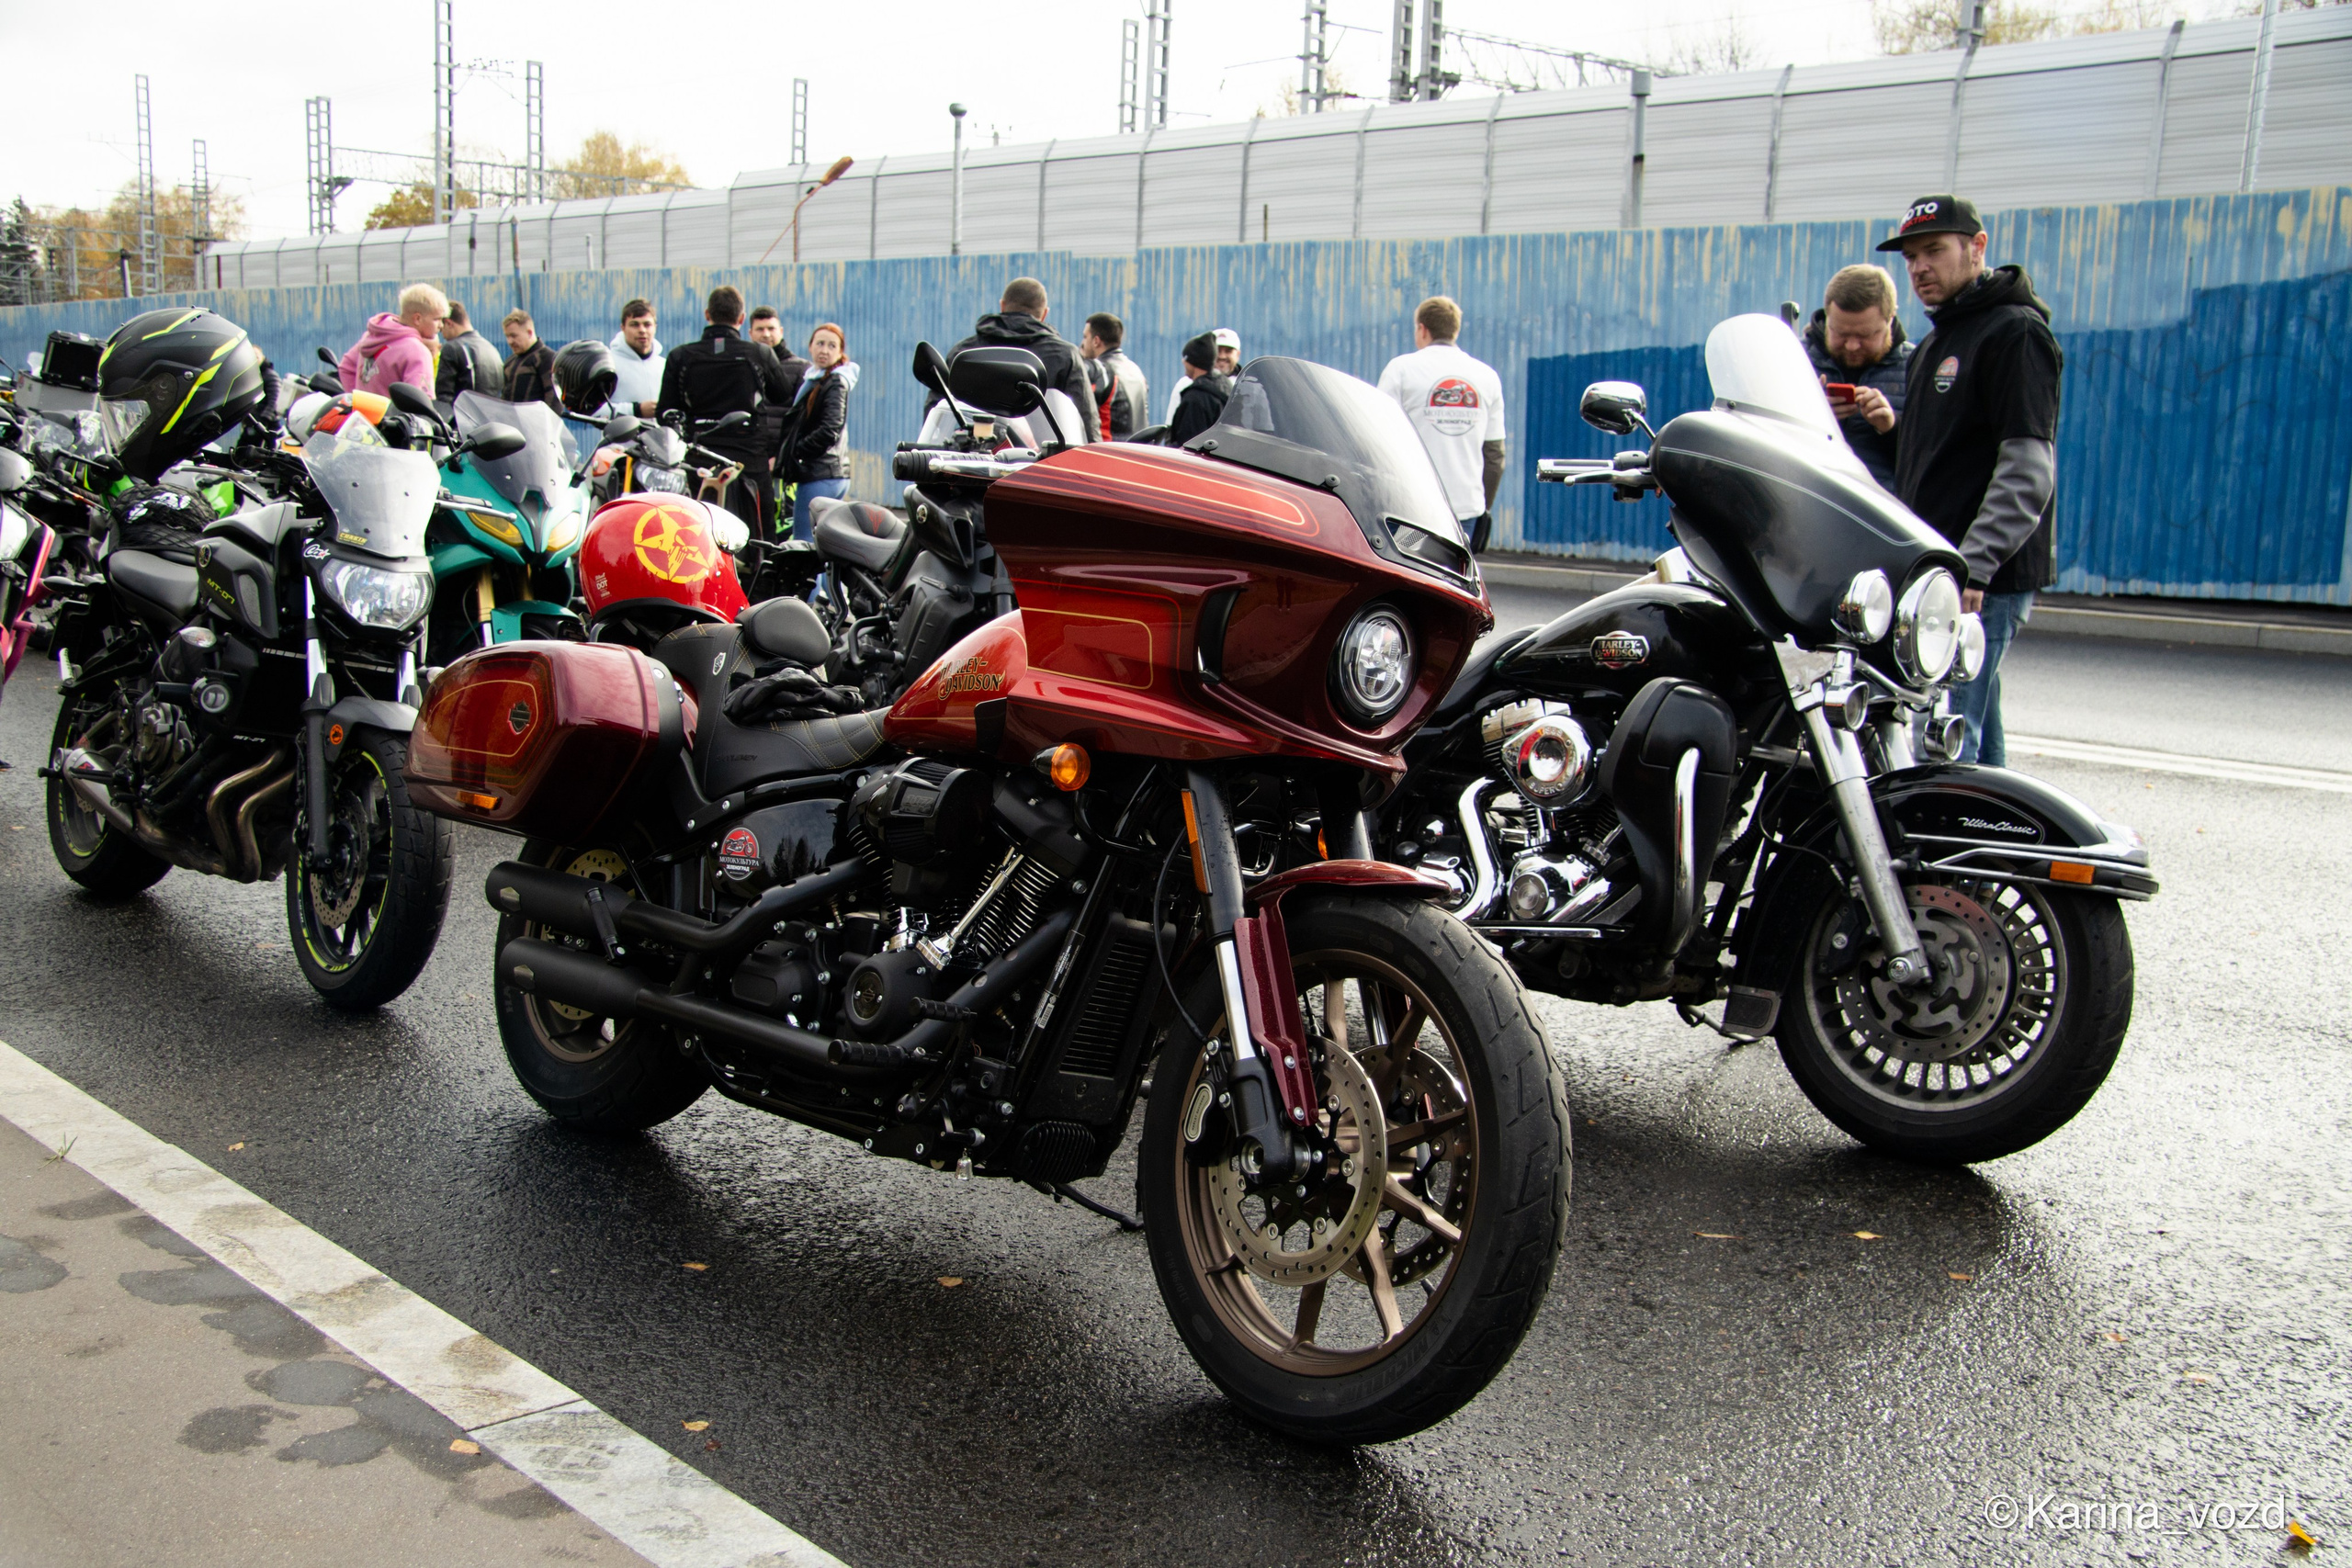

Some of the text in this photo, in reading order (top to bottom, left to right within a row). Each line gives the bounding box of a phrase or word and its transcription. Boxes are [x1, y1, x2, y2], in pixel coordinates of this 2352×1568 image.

[207, 578, 235, 605] MT-07
[596, 580, 608, 590] DOT
[1595, 649, 1643, 658] DAVIDSON
[940, 656, 989, 682] HARLEY-
[937, 670, 1006, 701] DAVIDSON
[719, 856, 760, 866] МОТОКУЛЬТУРА
[726, 863, 751, 872] ЗЕЛЕНОГРАД
[1339, 1334, 1430, 1405] MICHELIN
